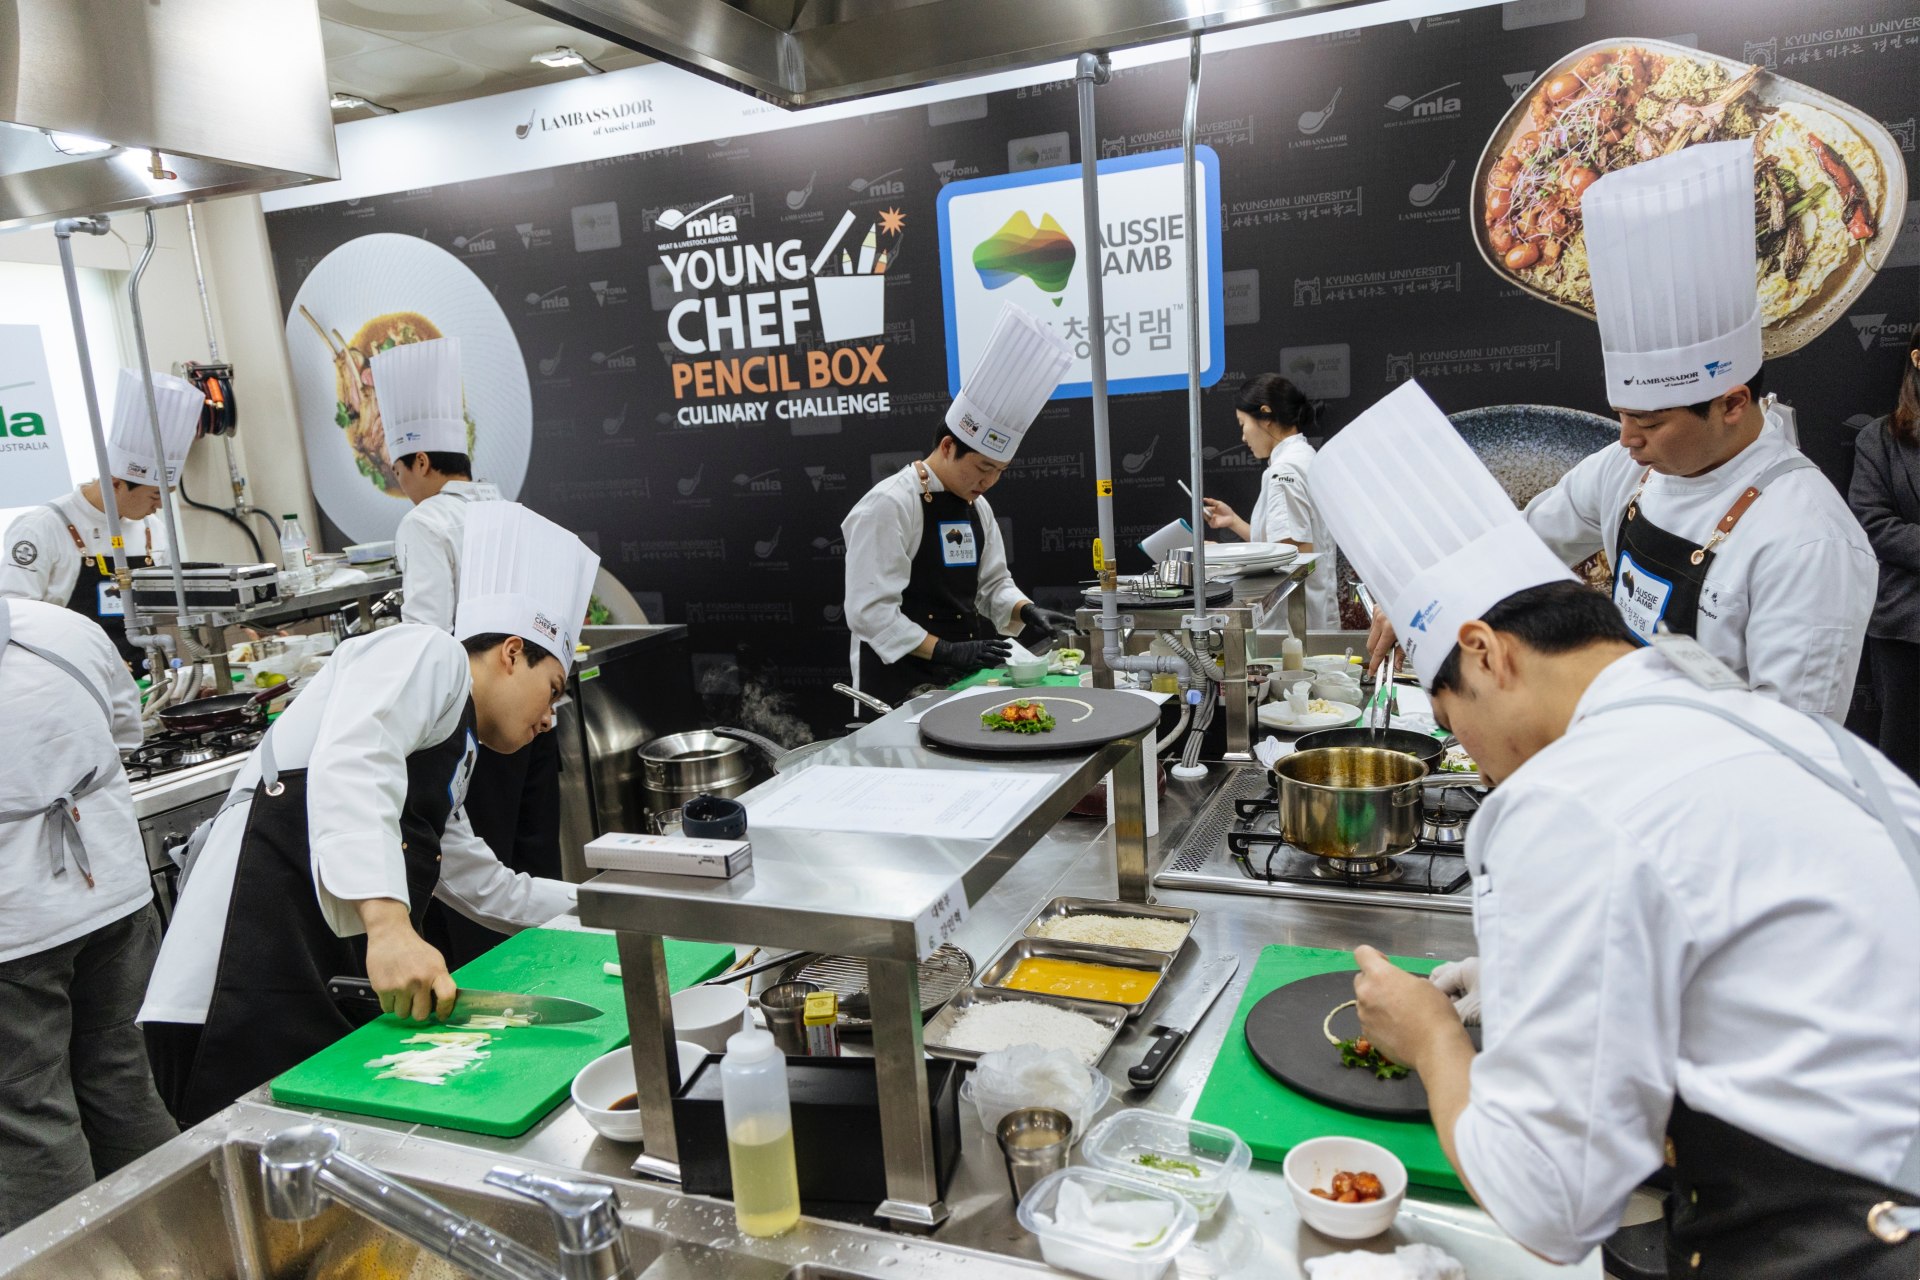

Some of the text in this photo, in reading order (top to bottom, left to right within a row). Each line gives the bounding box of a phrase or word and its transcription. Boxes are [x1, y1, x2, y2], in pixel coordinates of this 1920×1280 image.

[1785, 16, 1920, 47] KYUNGMIN UNIVER
[1873, 35, 1919, 53] 경민대
[541, 99, 653, 132] LAMBASSADOR
[1412, 97, 1462, 117] mla
[593, 118, 655, 136] of Aussie Lamb
[1130, 118, 1244, 143] KYUNGMIN NIVERSITY
[1288, 134, 1347, 149] LAMBASSADOR
[938, 166, 979, 178] VICTORIA
[869, 181, 905, 198] mla
[1232, 189, 1352, 212] KYUNGMIN UNIVERSITY
[1399, 208, 1461, 221] LAMBASSADOR
[686, 212, 737, 238] mla
[469, 239, 496, 253] mla
[658, 243, 673, 251] MEAT
[678, 238, 707, 249] LIVESTOCK
[708, 234, 738, 244] AUSTRALIA
[660, 239, 807, 292] YOUNG
[1102, 244, 1172, 277] AMB
[1325, 265, 1450, 286] KYUNGMIN UNIVERSITY
[541, 295, 570, 310] mla
[667, 287, 811, 354] CHEF
[1419, 343, 1550, 362] KYUNGMIN UNIVERSITY
[607, 356, 636, 369] mla
[672, 344, 888, 399] PENCIL BOX
[1636, 371, 1699, 386] LAMBASSADOR
[677, 392, 891, 426] CULINARY CHALLENGE
[0, 442, 49, 452] USTRALIA
[1027, 454, 1076, 465] UNIVERSITY
[1221, 451, 1262, 467] mla
[750, 478, 782, 492] mla
[1634, 594, 1653, 610] LAMB
[1635, 586, 1659, 604] AUSSIE
